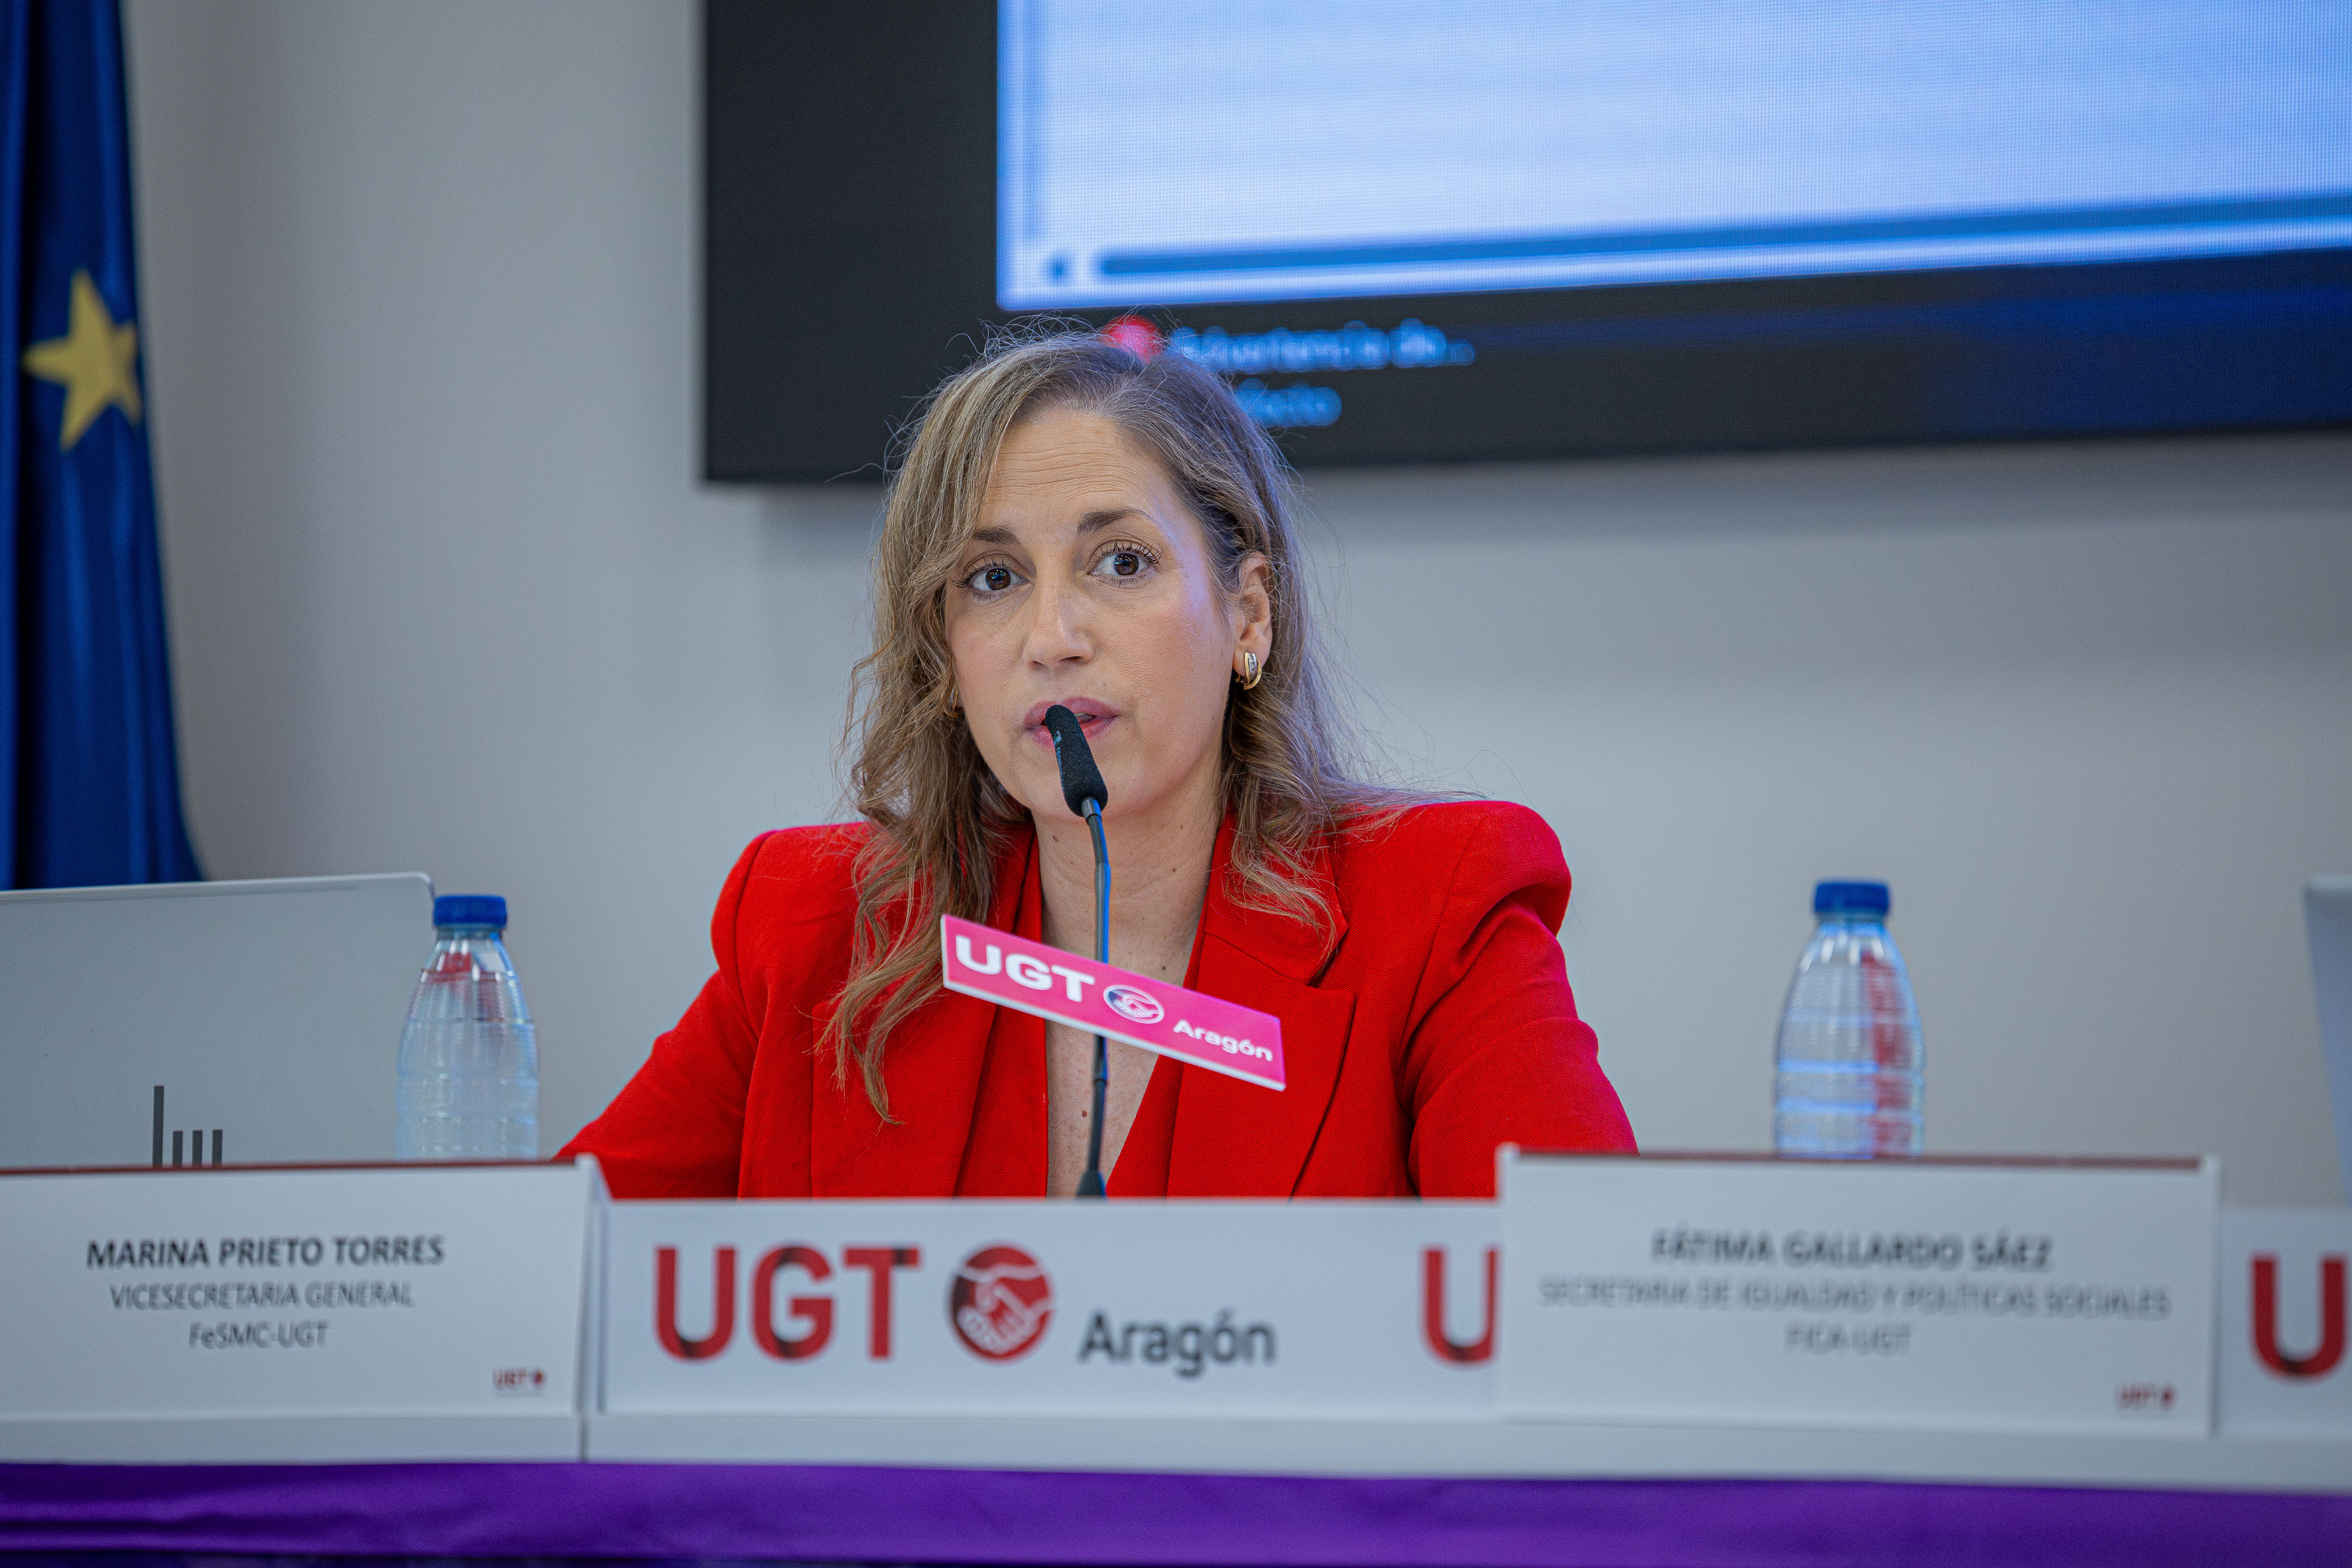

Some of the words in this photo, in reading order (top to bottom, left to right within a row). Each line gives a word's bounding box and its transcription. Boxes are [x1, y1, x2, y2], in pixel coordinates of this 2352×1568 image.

[955, 935, 1095, 1002] UGT
[1173, 1019, 1273, 1062] Aragón
[86, 1239, 211, 1269] MARINA
[218, 1237, 324, 1267] PRIETO
[333, 1235, 445, 1266] TORRES
[1652, 1223, 1774, 1263] FÁTIMA
[1784, 1232, 1962, 1269] GALLARDO
[1970, 1227, 2053, 1271] SÁEZ
[109, 1282, 299, 1310] VICESECRETARIA
[304, 1281, 414, 1308] GENERAL
[652, 1242, 922, 1365] UGT
[1077, 1310, 1277, 1380] Aragón
[1541, 1276, 1691, 1308] SECRETARIA
[1698, 1279, 1732, 1308] DE
[2045, 1287, 2172, 1318] SOCIALES
[189, 1321, 328, 1348] FeSMC-UGT
